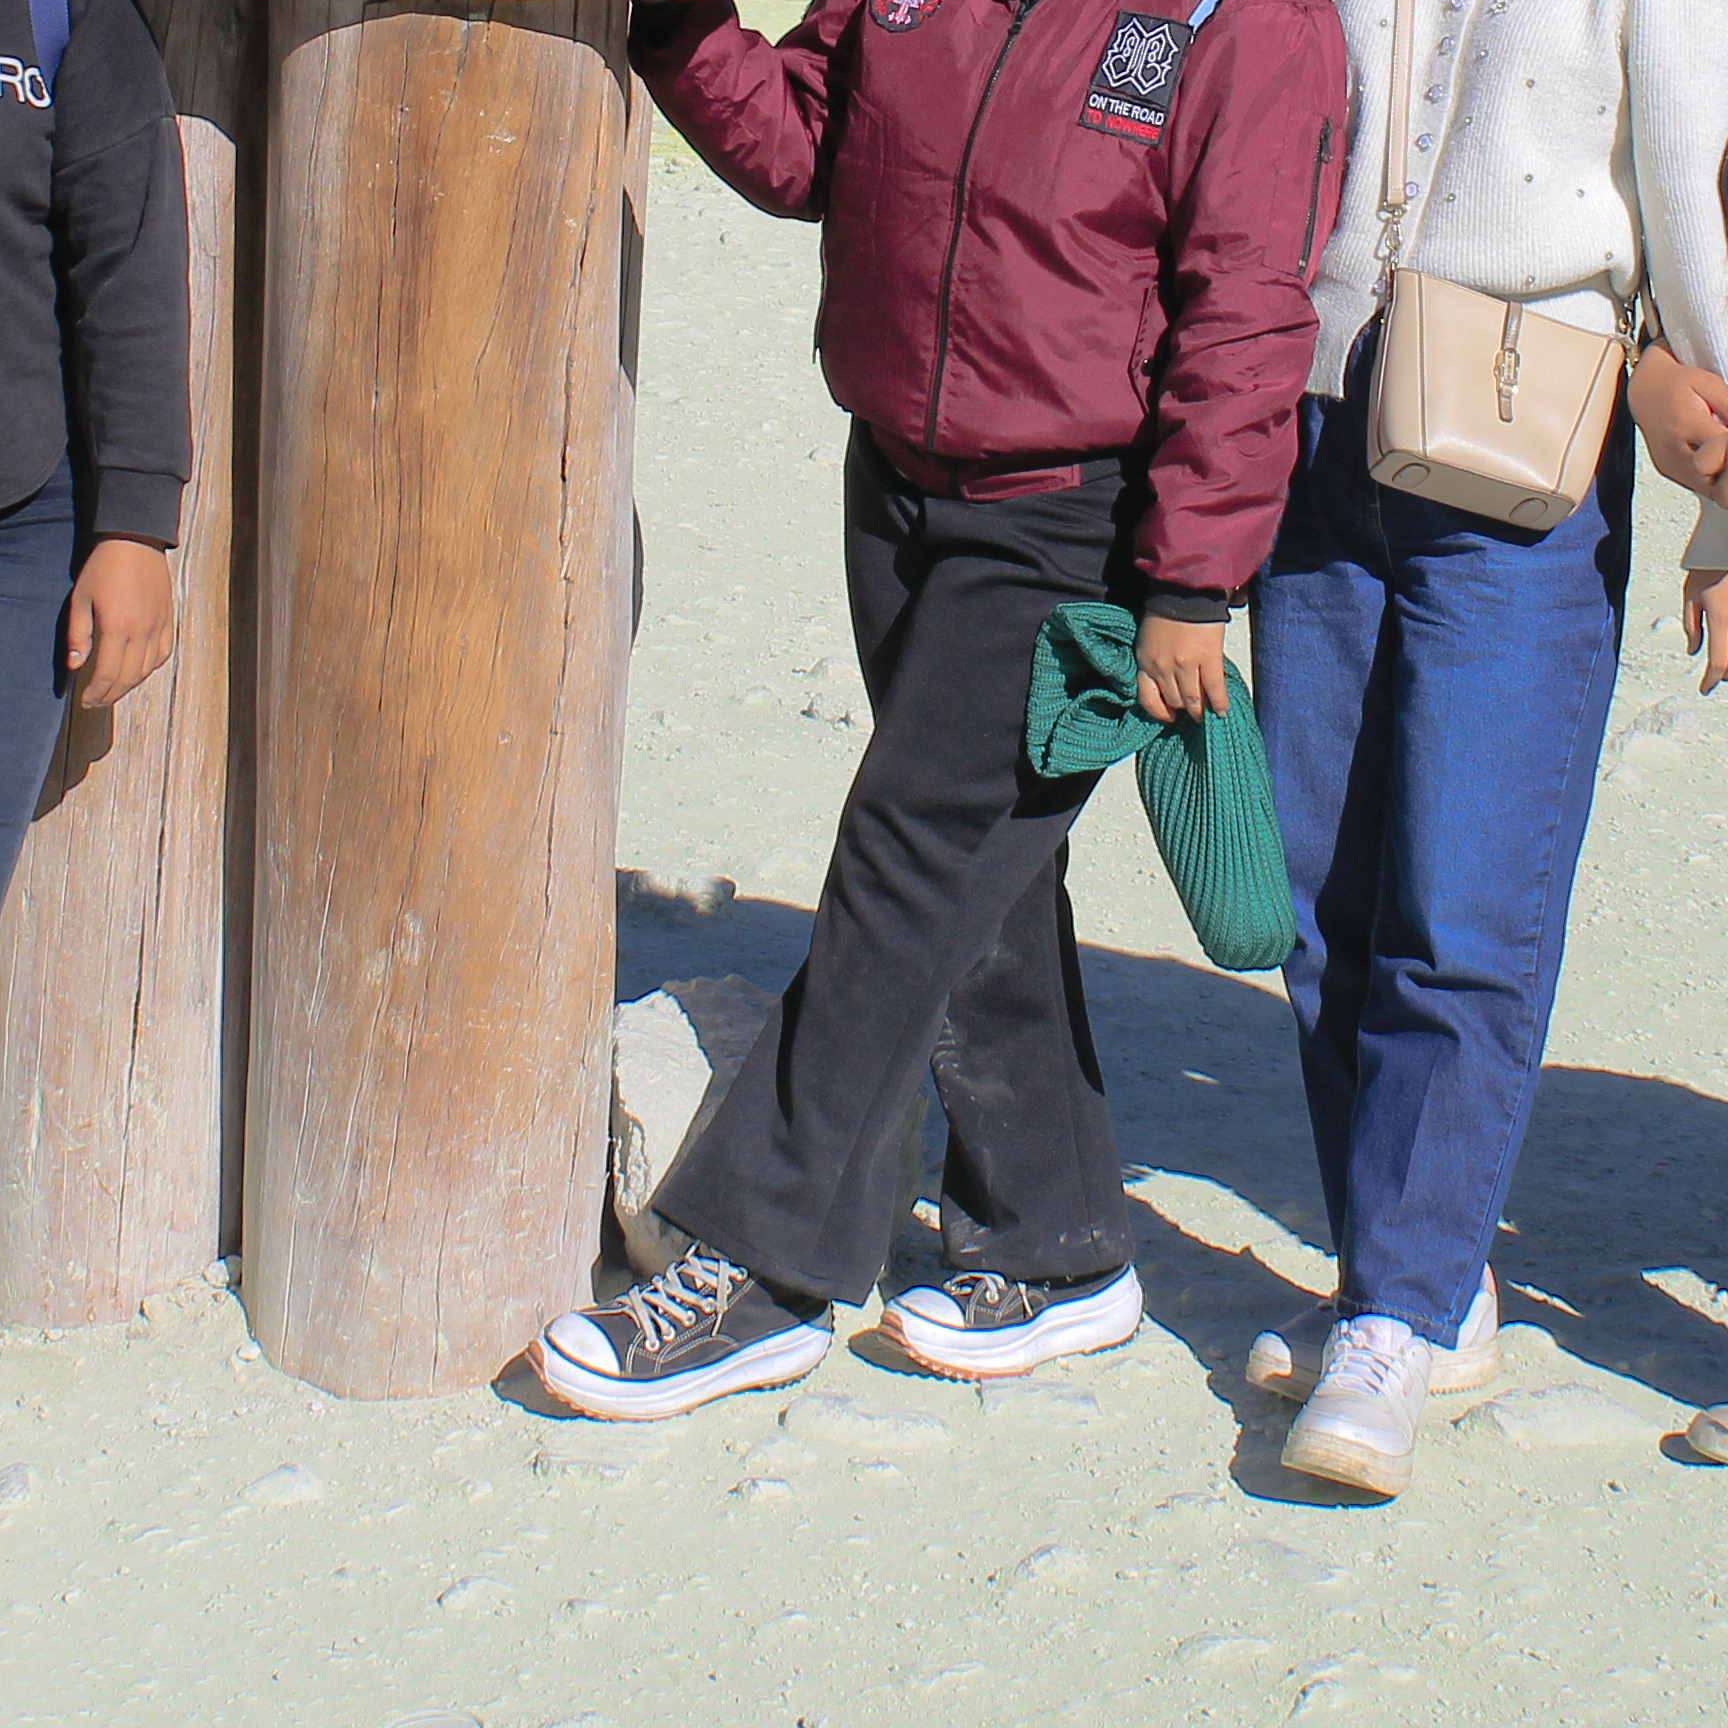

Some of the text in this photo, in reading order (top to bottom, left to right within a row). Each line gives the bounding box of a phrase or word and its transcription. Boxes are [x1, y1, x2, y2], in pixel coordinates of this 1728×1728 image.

[1090, 94, 1164, 125] ON THE ROAD
